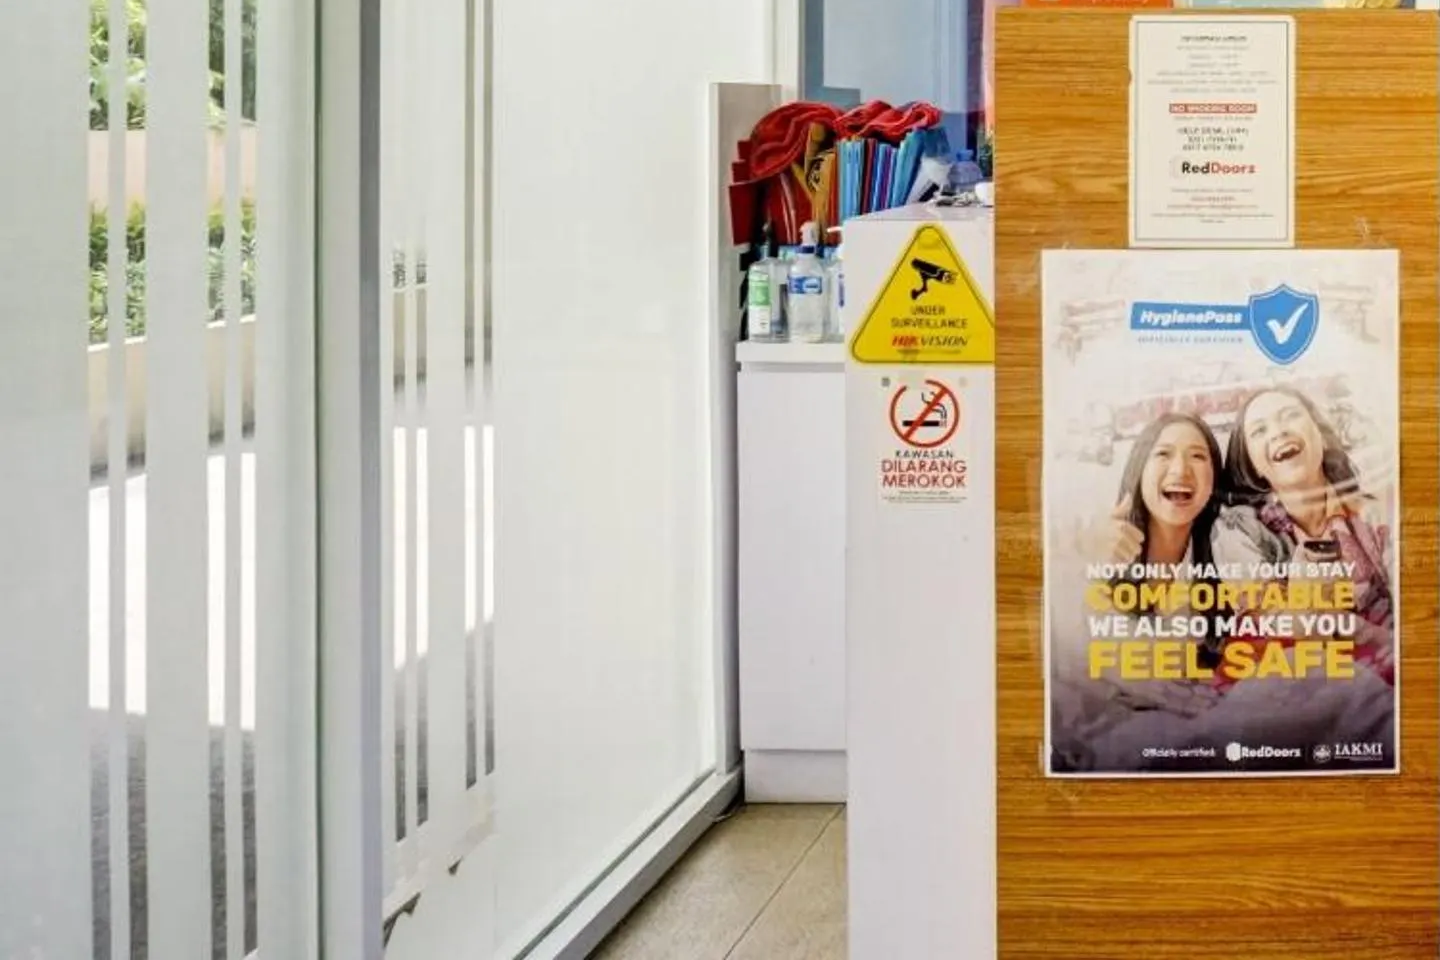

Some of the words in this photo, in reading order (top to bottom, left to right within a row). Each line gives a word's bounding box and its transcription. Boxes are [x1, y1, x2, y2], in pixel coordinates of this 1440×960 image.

[910, 304, 946, 315] UNDER
[891, 318, 968, 329] SURVEILLANCE
[1140, 310, 1243, 328] HygienePass
[895, 450, 954, 459] KAWASAN
[881, 460, 967, 473] DILARANG
[882, 473, 966, 488] MEROKOK
[1086, 564, 1127, 579] NOT
[1132, 563, 1184, 579] ONLY
[1187, 563, 1242, 578] MAKE
[1249, 563, 1301, 578] YOUR
[1305, 562, 1357, 577] STAY
[1086, 581, 1355, 612] COMFORTABLE
[1089, 616, 1128, 637] WE
[1134, 615, 1209, 637] ALSO
[1214, 615, 1294, 637] MAKE
[1300, 614, 1357, 636] YOU
[1088, 641, 1213, 679] FEEL
[1223, 640, 1355, 679] SAFE
[1335, 742, 1383, 755] IAKMI
